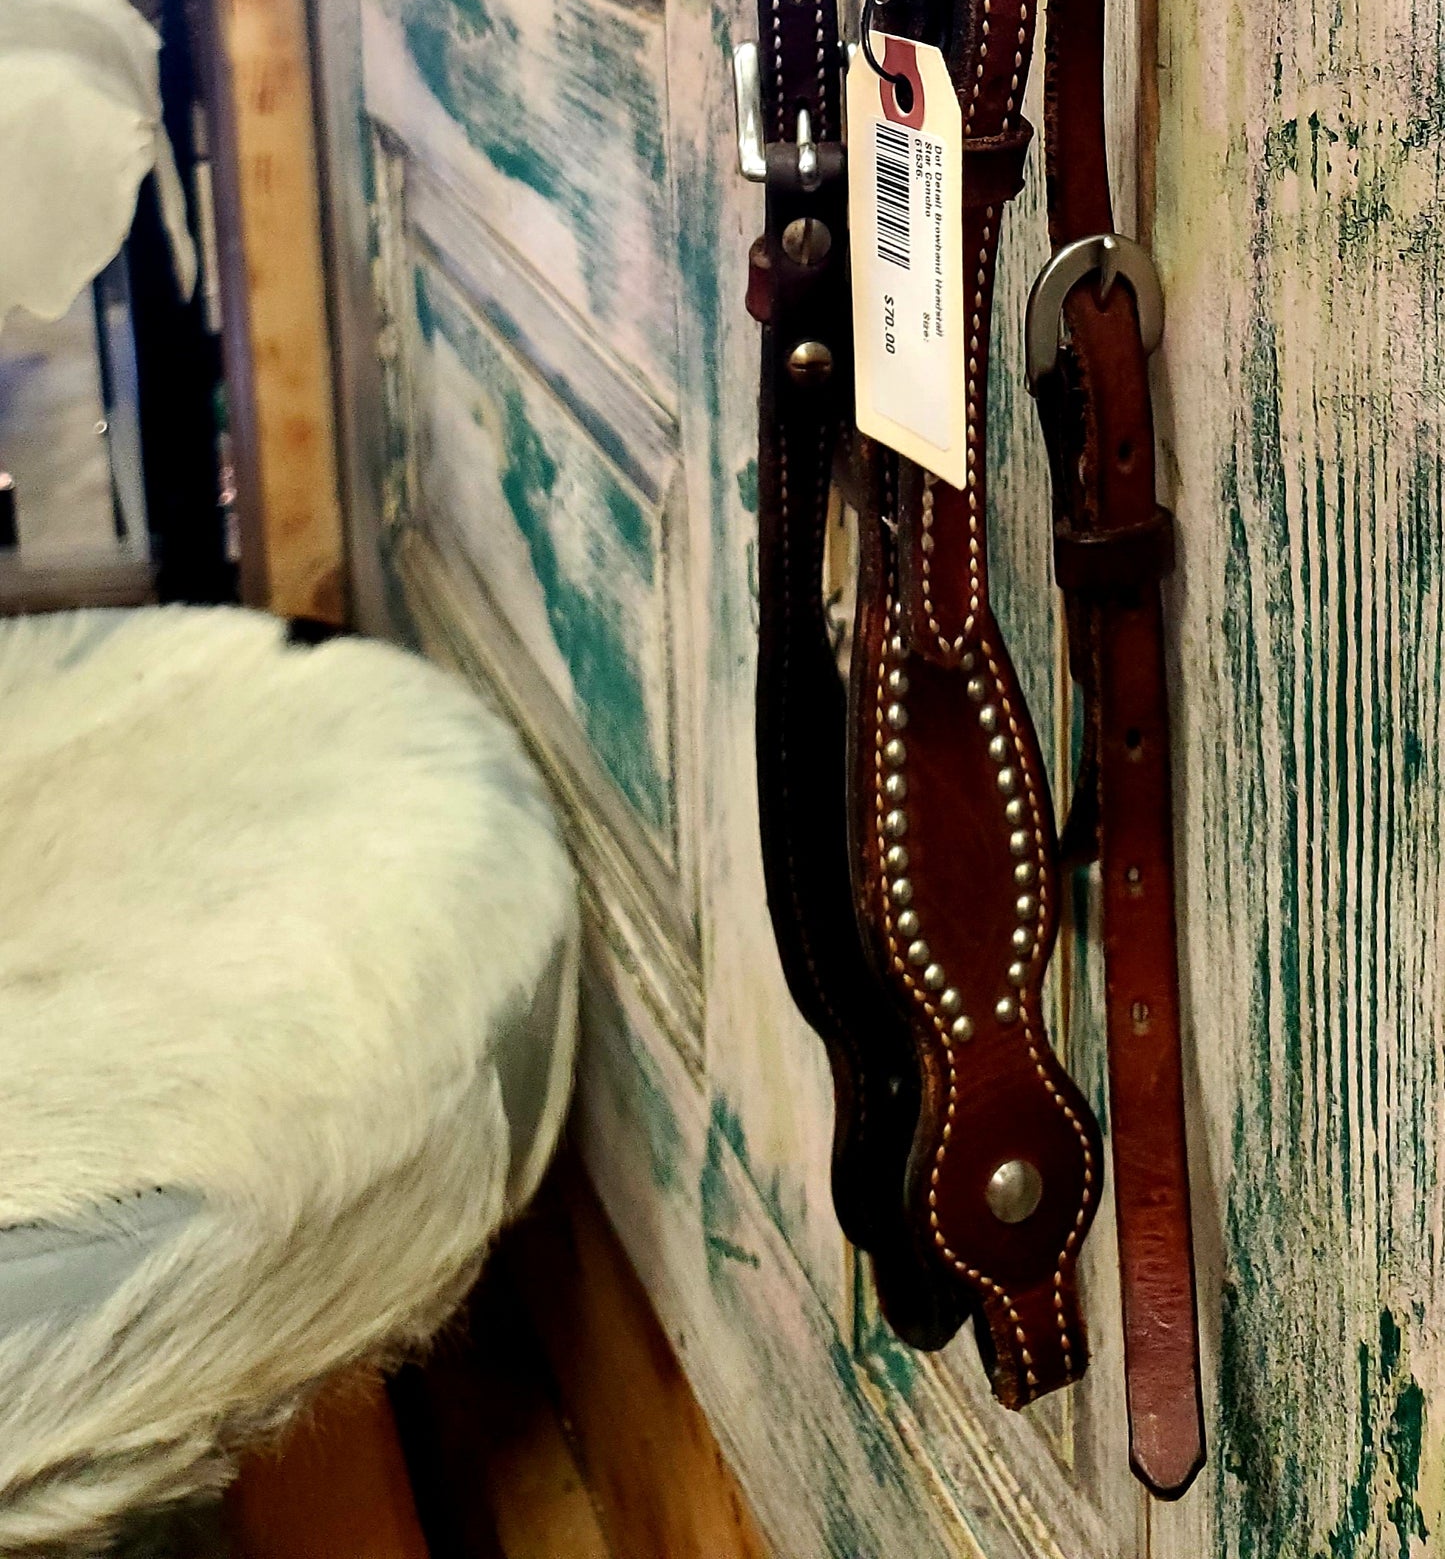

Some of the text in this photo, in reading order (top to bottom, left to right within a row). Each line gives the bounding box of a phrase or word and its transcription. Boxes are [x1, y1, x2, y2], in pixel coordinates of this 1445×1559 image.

[934, 145, 944, 337] Dot Detail Browband Headstall
[884, 294, 895, 354] $70.00
[923, 312, 931, 343] Size:
